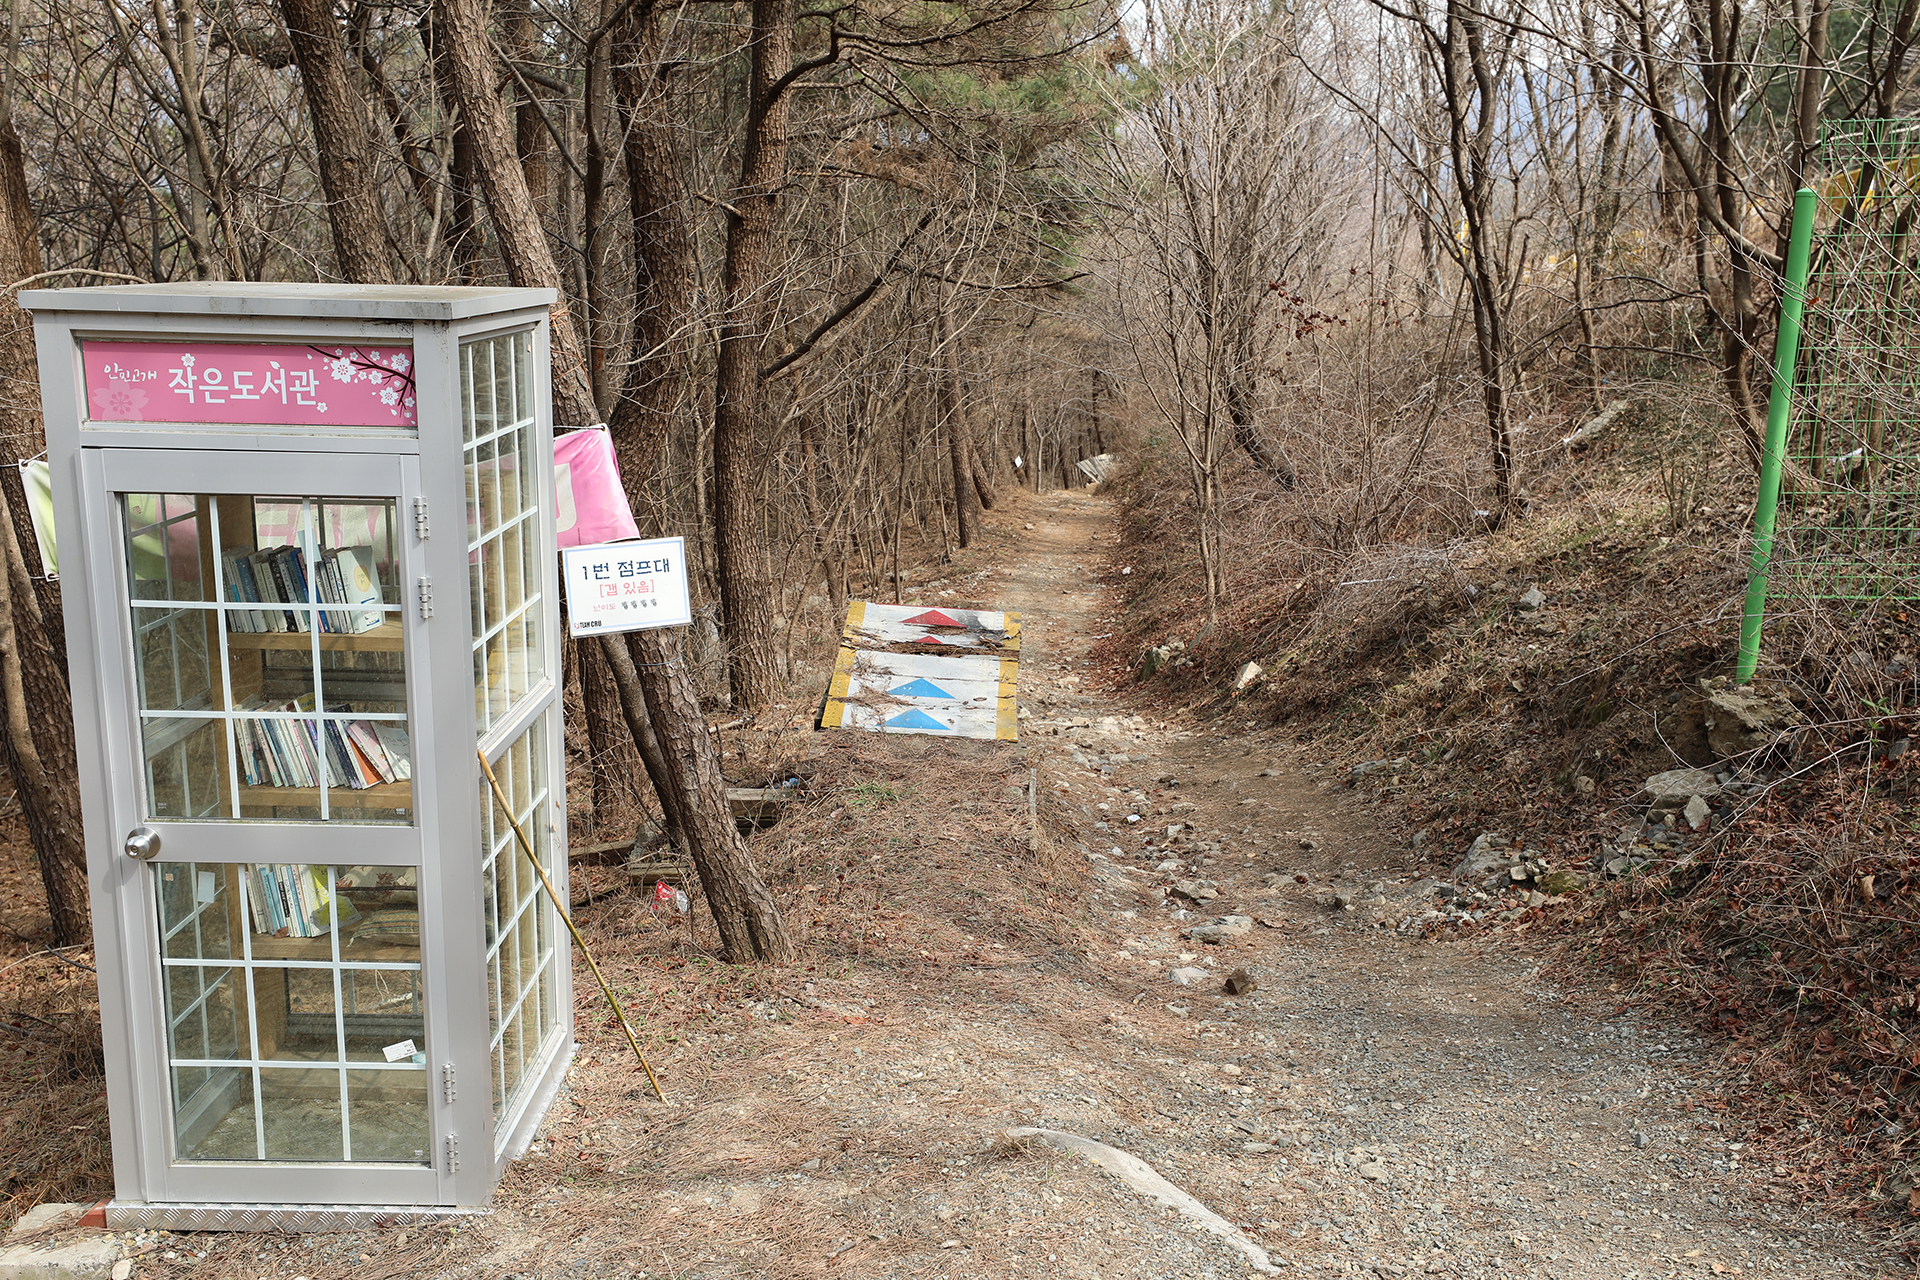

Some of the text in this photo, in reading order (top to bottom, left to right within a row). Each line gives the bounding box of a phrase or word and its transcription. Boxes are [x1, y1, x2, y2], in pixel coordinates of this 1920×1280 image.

[104, 362, 320, 405] 안민고개 작은도서관
[617, 557, 670, 578] 점프대
[593, 602, 617, 612] 난이도
